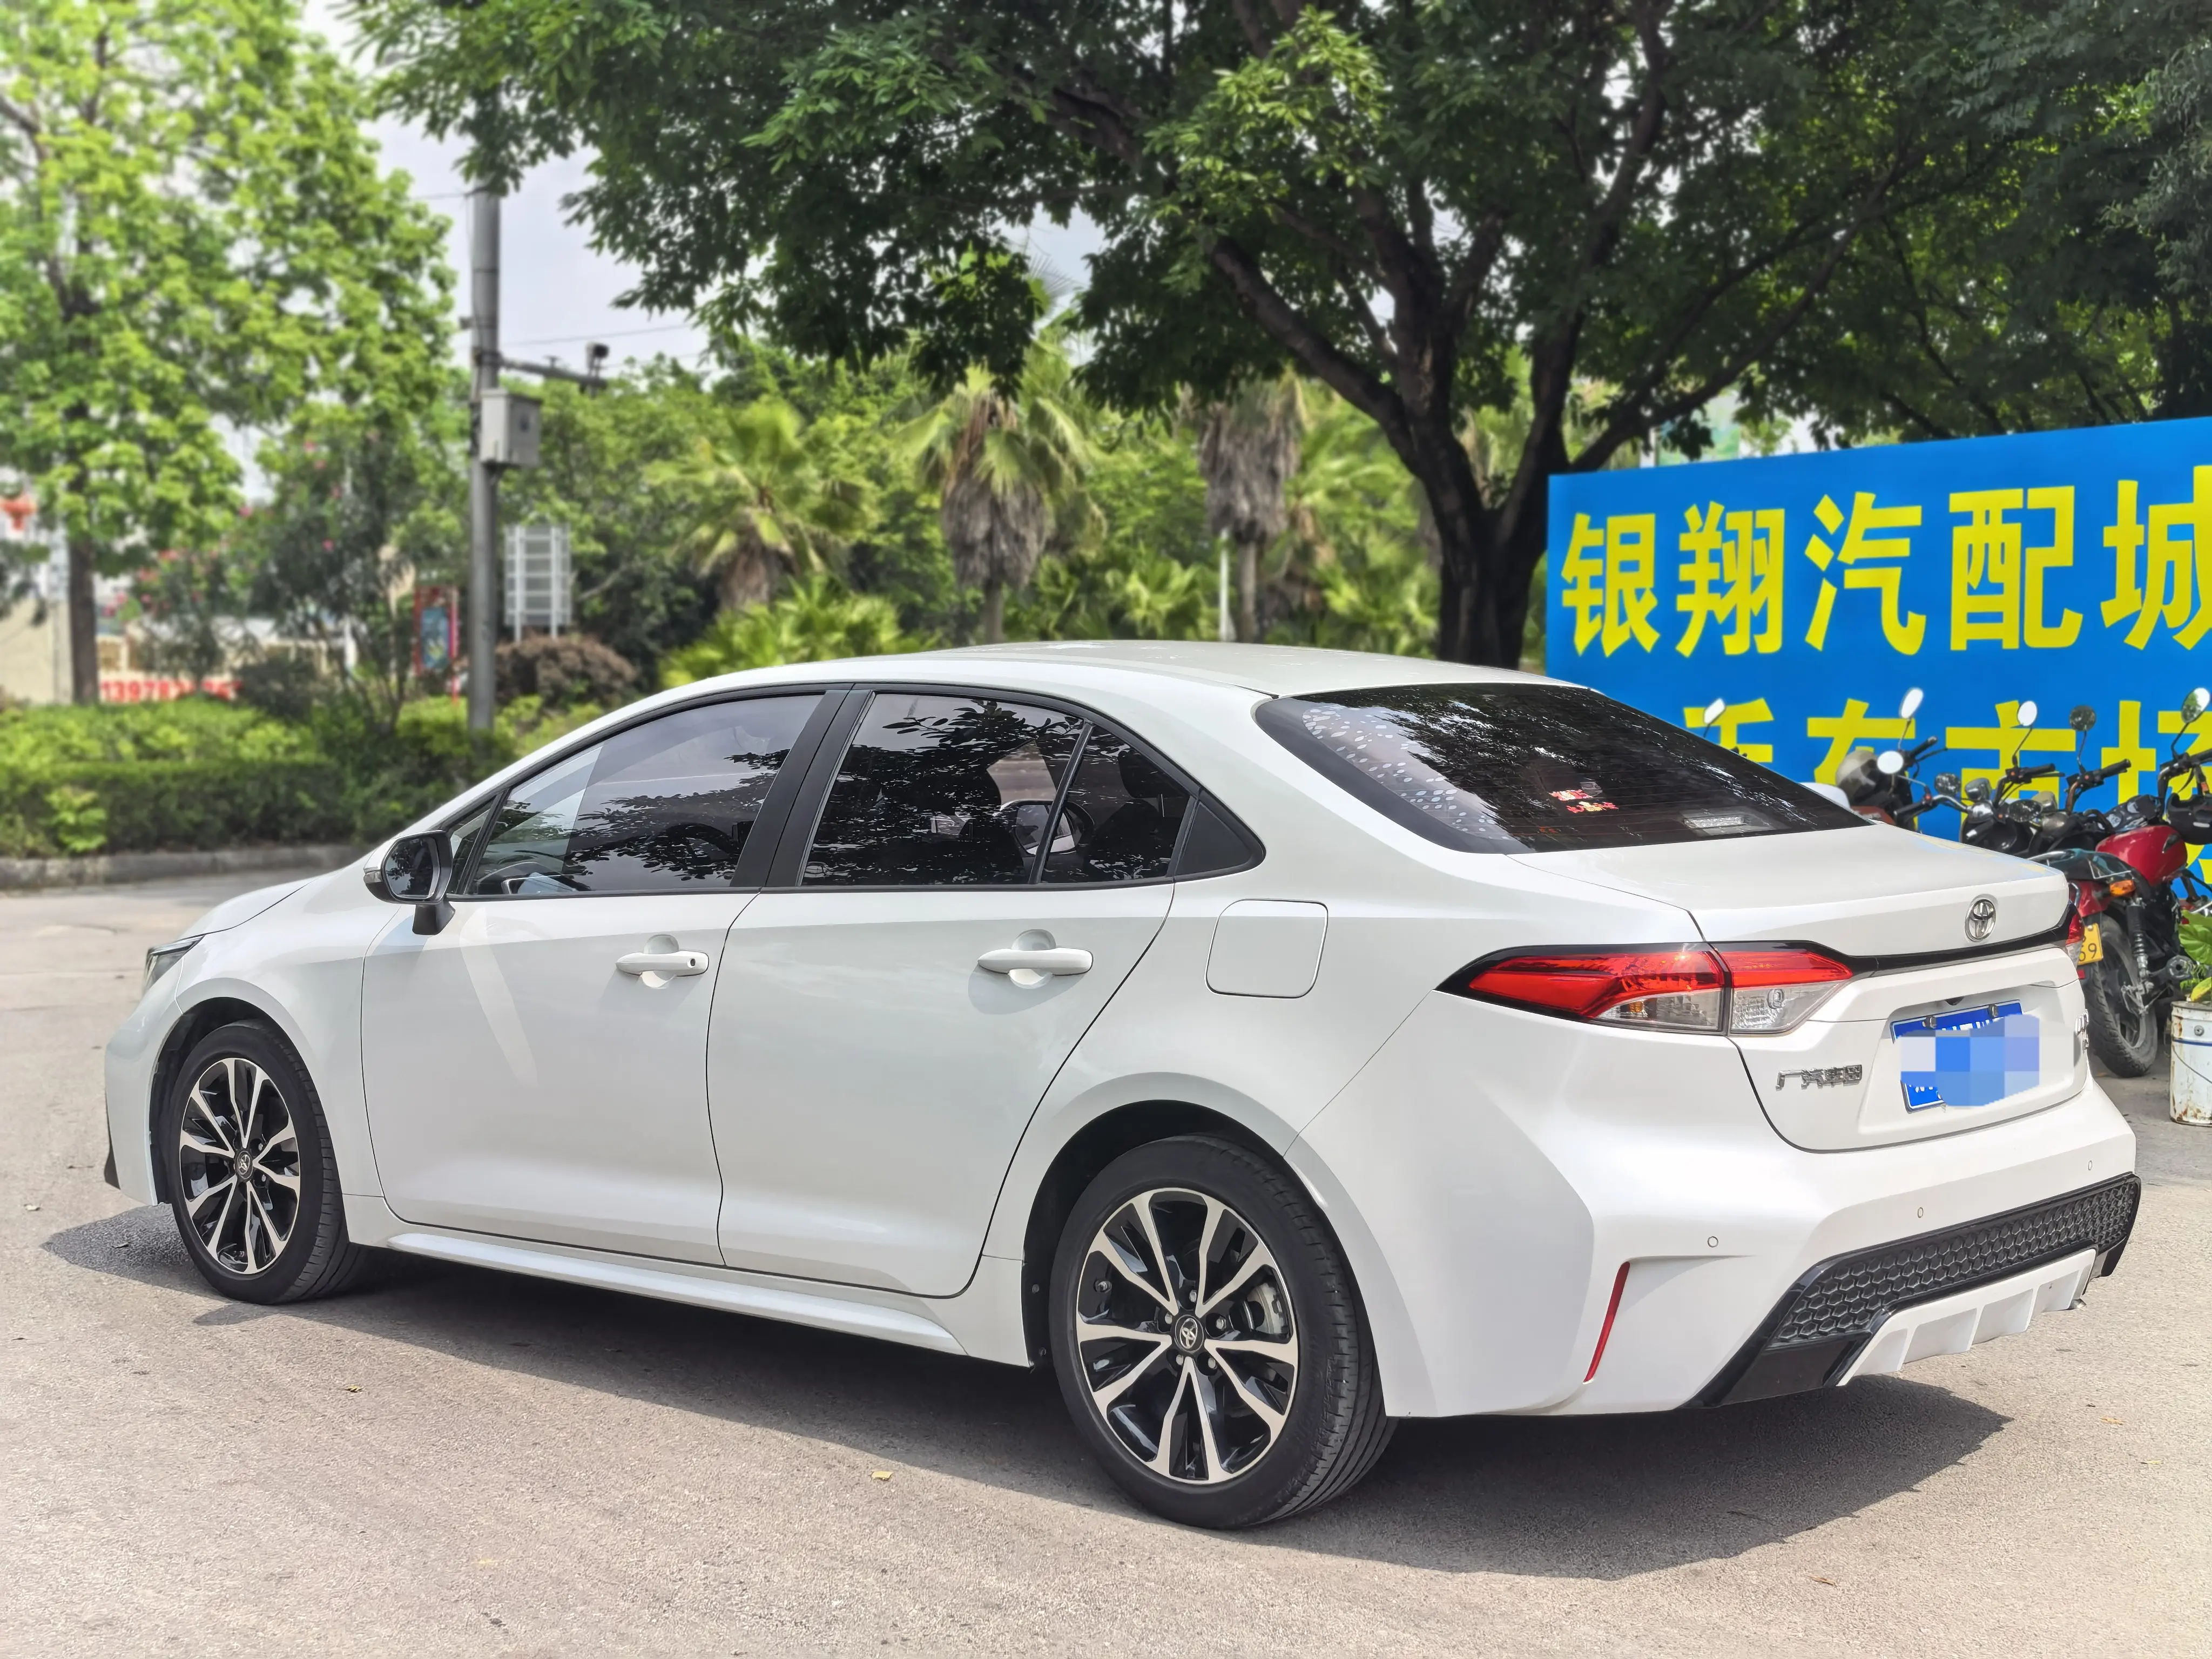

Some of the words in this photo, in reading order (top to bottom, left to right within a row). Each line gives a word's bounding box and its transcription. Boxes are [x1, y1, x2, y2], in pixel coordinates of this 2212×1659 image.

[1561, 466, 2212, 656] 银翔汽配城
